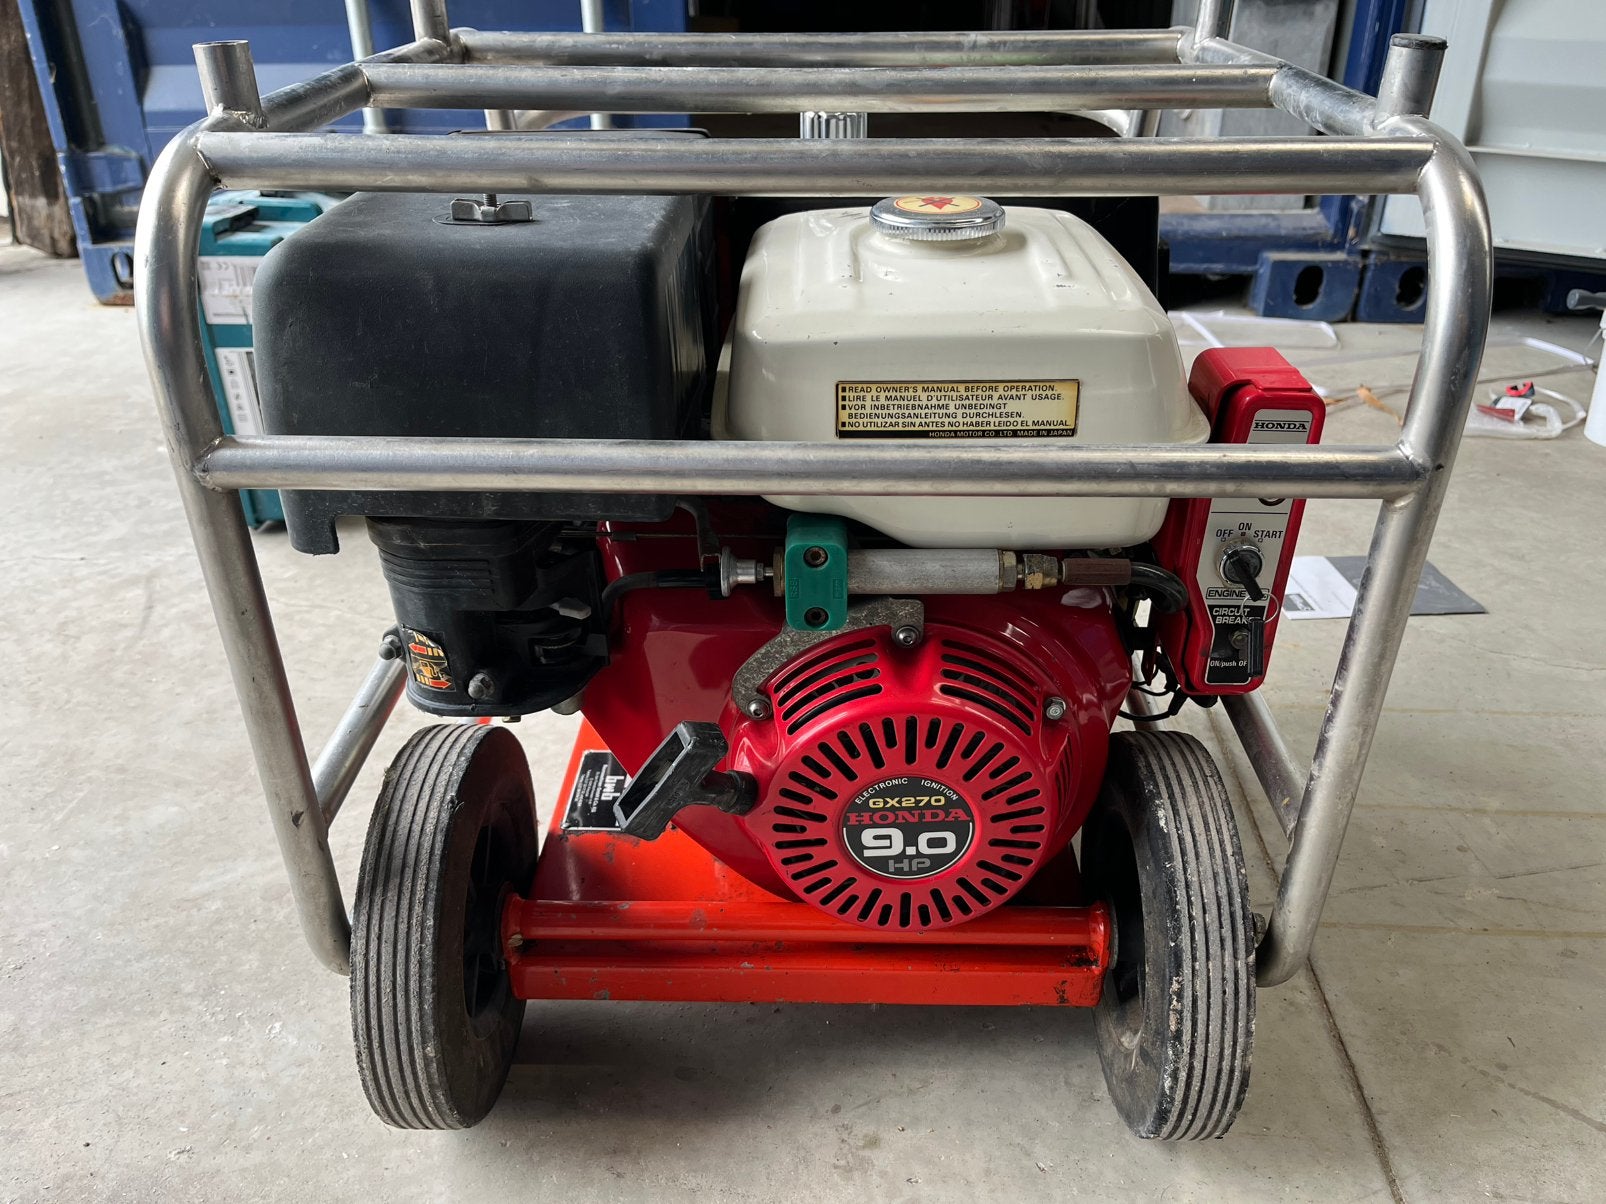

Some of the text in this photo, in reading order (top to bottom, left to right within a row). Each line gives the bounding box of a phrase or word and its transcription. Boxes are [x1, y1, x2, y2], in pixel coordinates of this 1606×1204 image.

[870, 403, 950, 411] INBETRIEBNAHME
[848, 412, 958, 420] BEDIENUNGSANLEITUNG
[1253, 422, 1307, 430] HONDA
[1238, 522, 1252, 531] ON
[1215, 529, 1234, 537] OFF
[1253, 530, 1283, 538] START
[1207, 589, 1247, 597] ENGINE
[1215, 616, 1252, 625] BREAK
[854, 777, 909, 805] ELECTRONIC
[920, 779, 959, 801] IGNITION
[868, 795, 946, 809] GX270
[847, 808, 970, 825] HONDA
[860, 827, 957, 857] 9.0
[888, 857, 931, 873] HP
